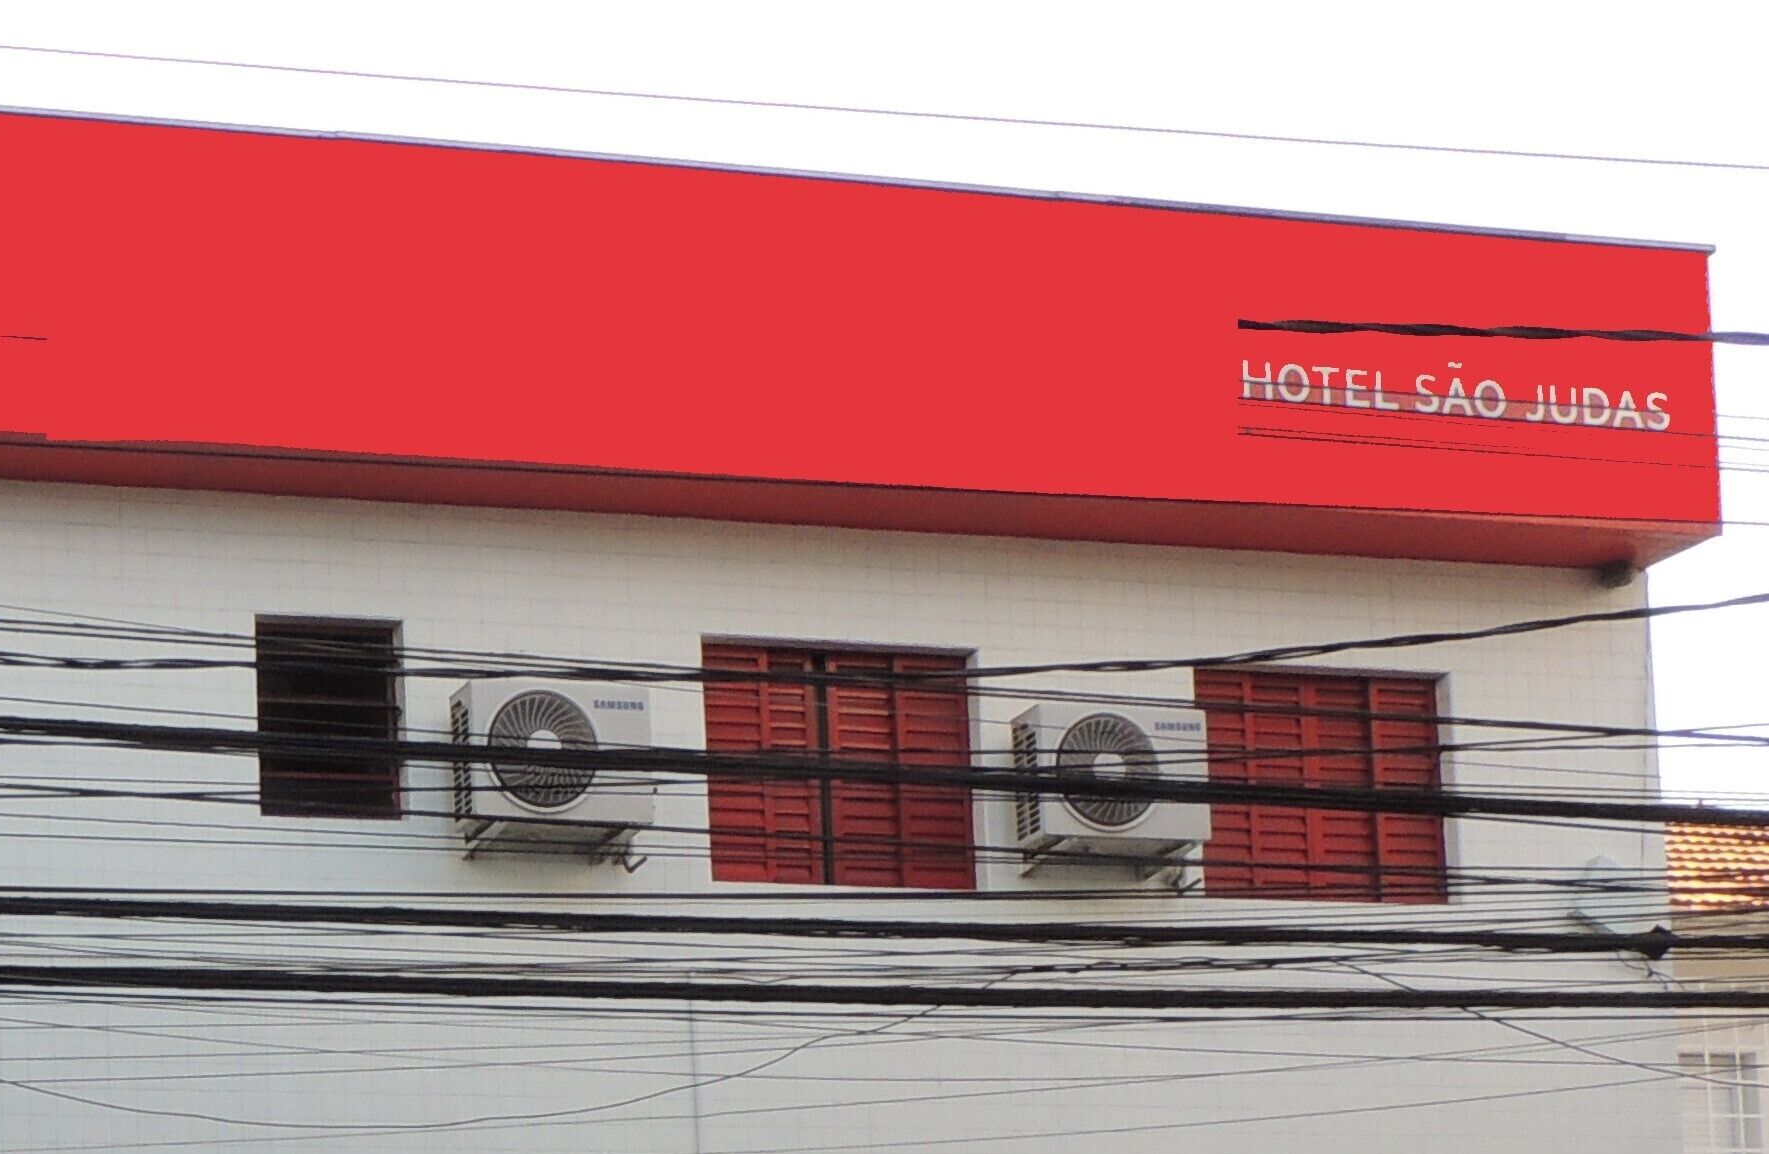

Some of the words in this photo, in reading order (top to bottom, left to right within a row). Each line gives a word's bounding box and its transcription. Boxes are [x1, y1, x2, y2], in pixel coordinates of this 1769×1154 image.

[1241, 359, 1399, 412] HOTEL
[1414, 361, 1507, 418] SÃO
[1525, 384, 1671, 431] JUDAS
